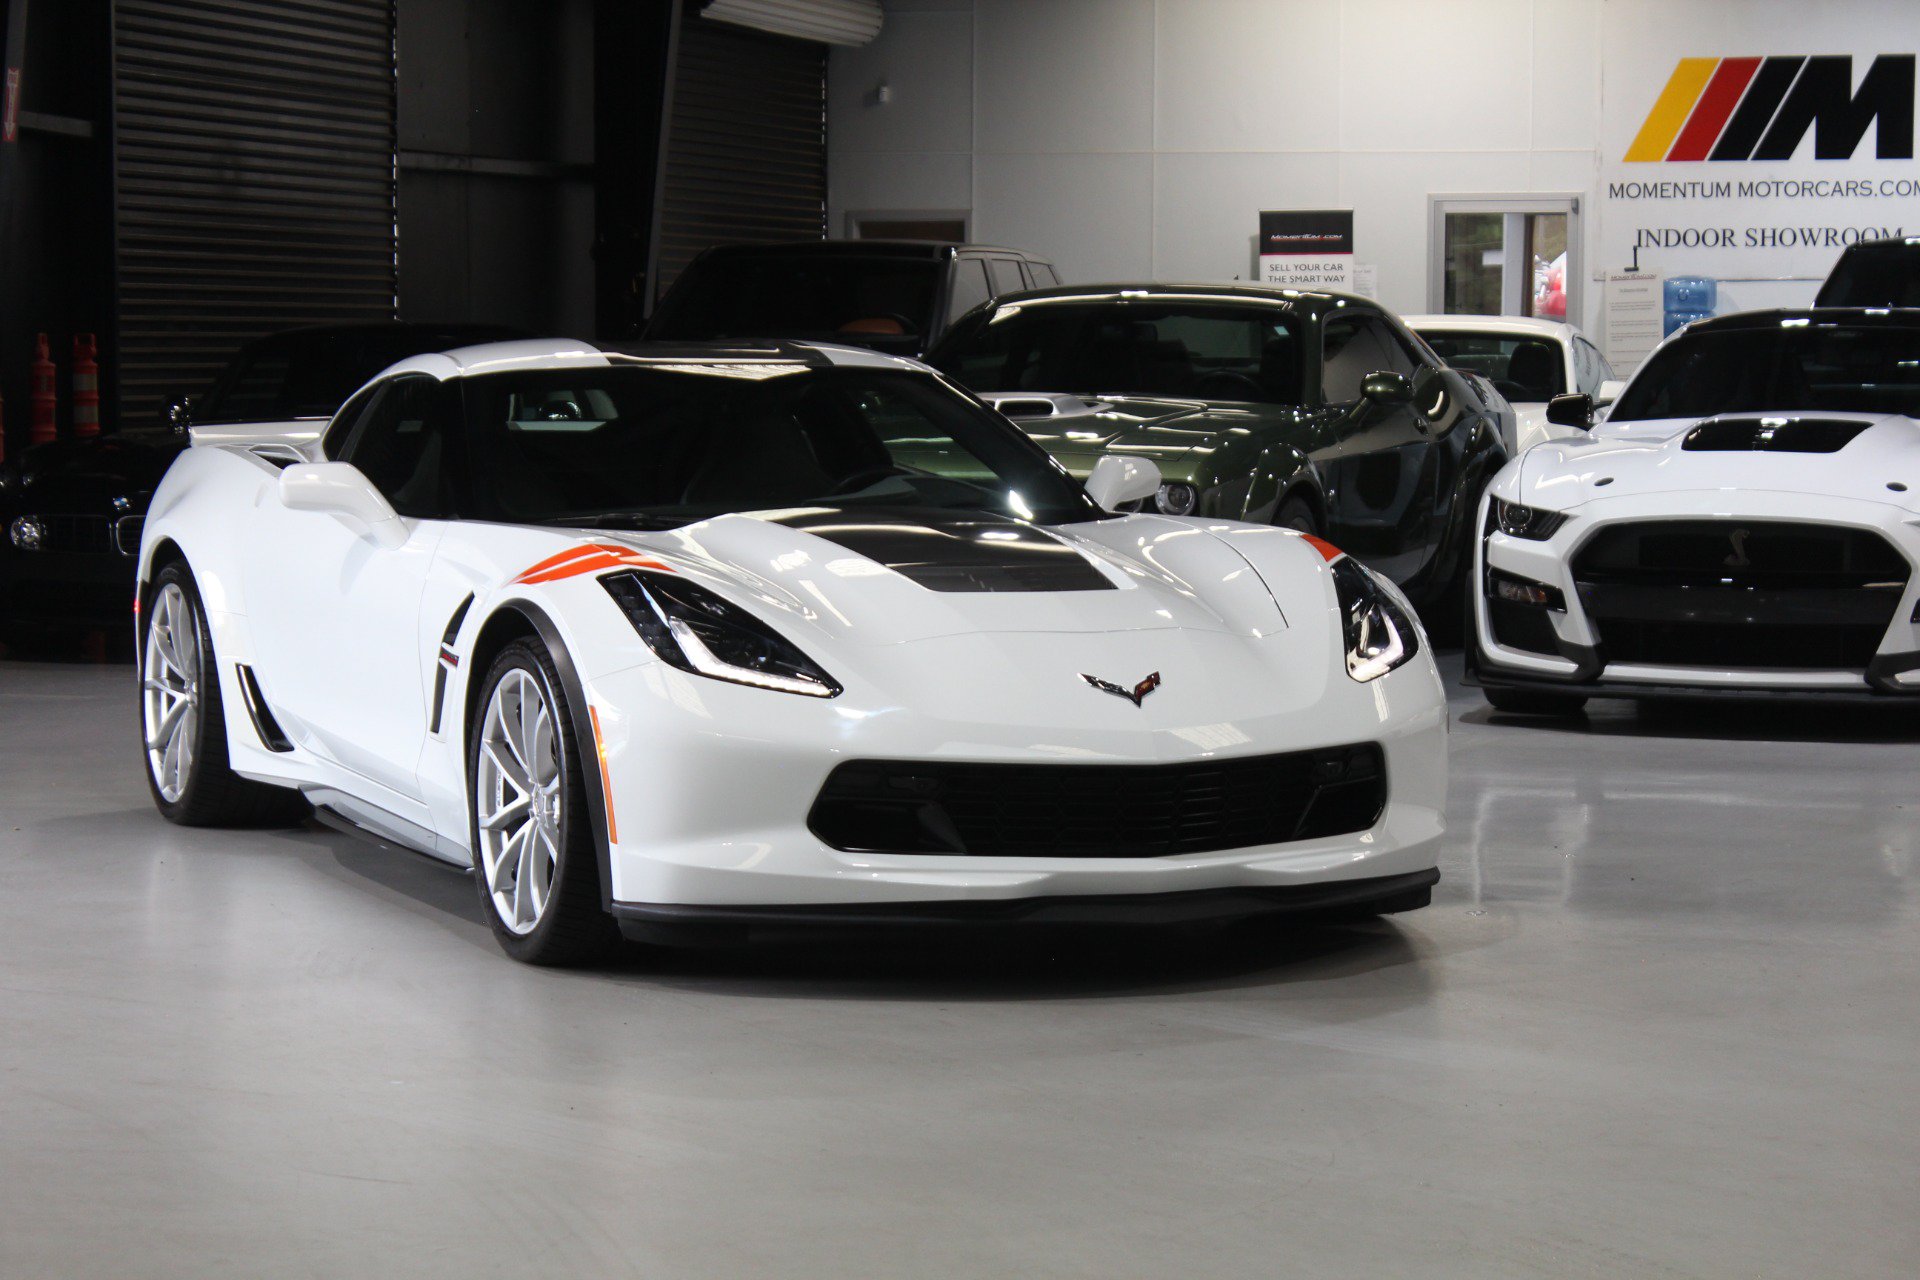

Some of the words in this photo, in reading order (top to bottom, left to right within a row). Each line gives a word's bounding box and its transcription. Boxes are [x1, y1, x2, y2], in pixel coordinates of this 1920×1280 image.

[1608, 181, 1731, 199] MOMENTUM
[1636, 228, 1737, 248] INDOOR
[1269, 263, 1291, 272] SELL
[1293, 263, 1321, 271] YOUR
[1323, 263, 1344, 271] CAR
[1267, 275, 1287, 283] THE
[1289, 274, 1321, 283] SMART
[1323, 274, 1346, 283] WAY
